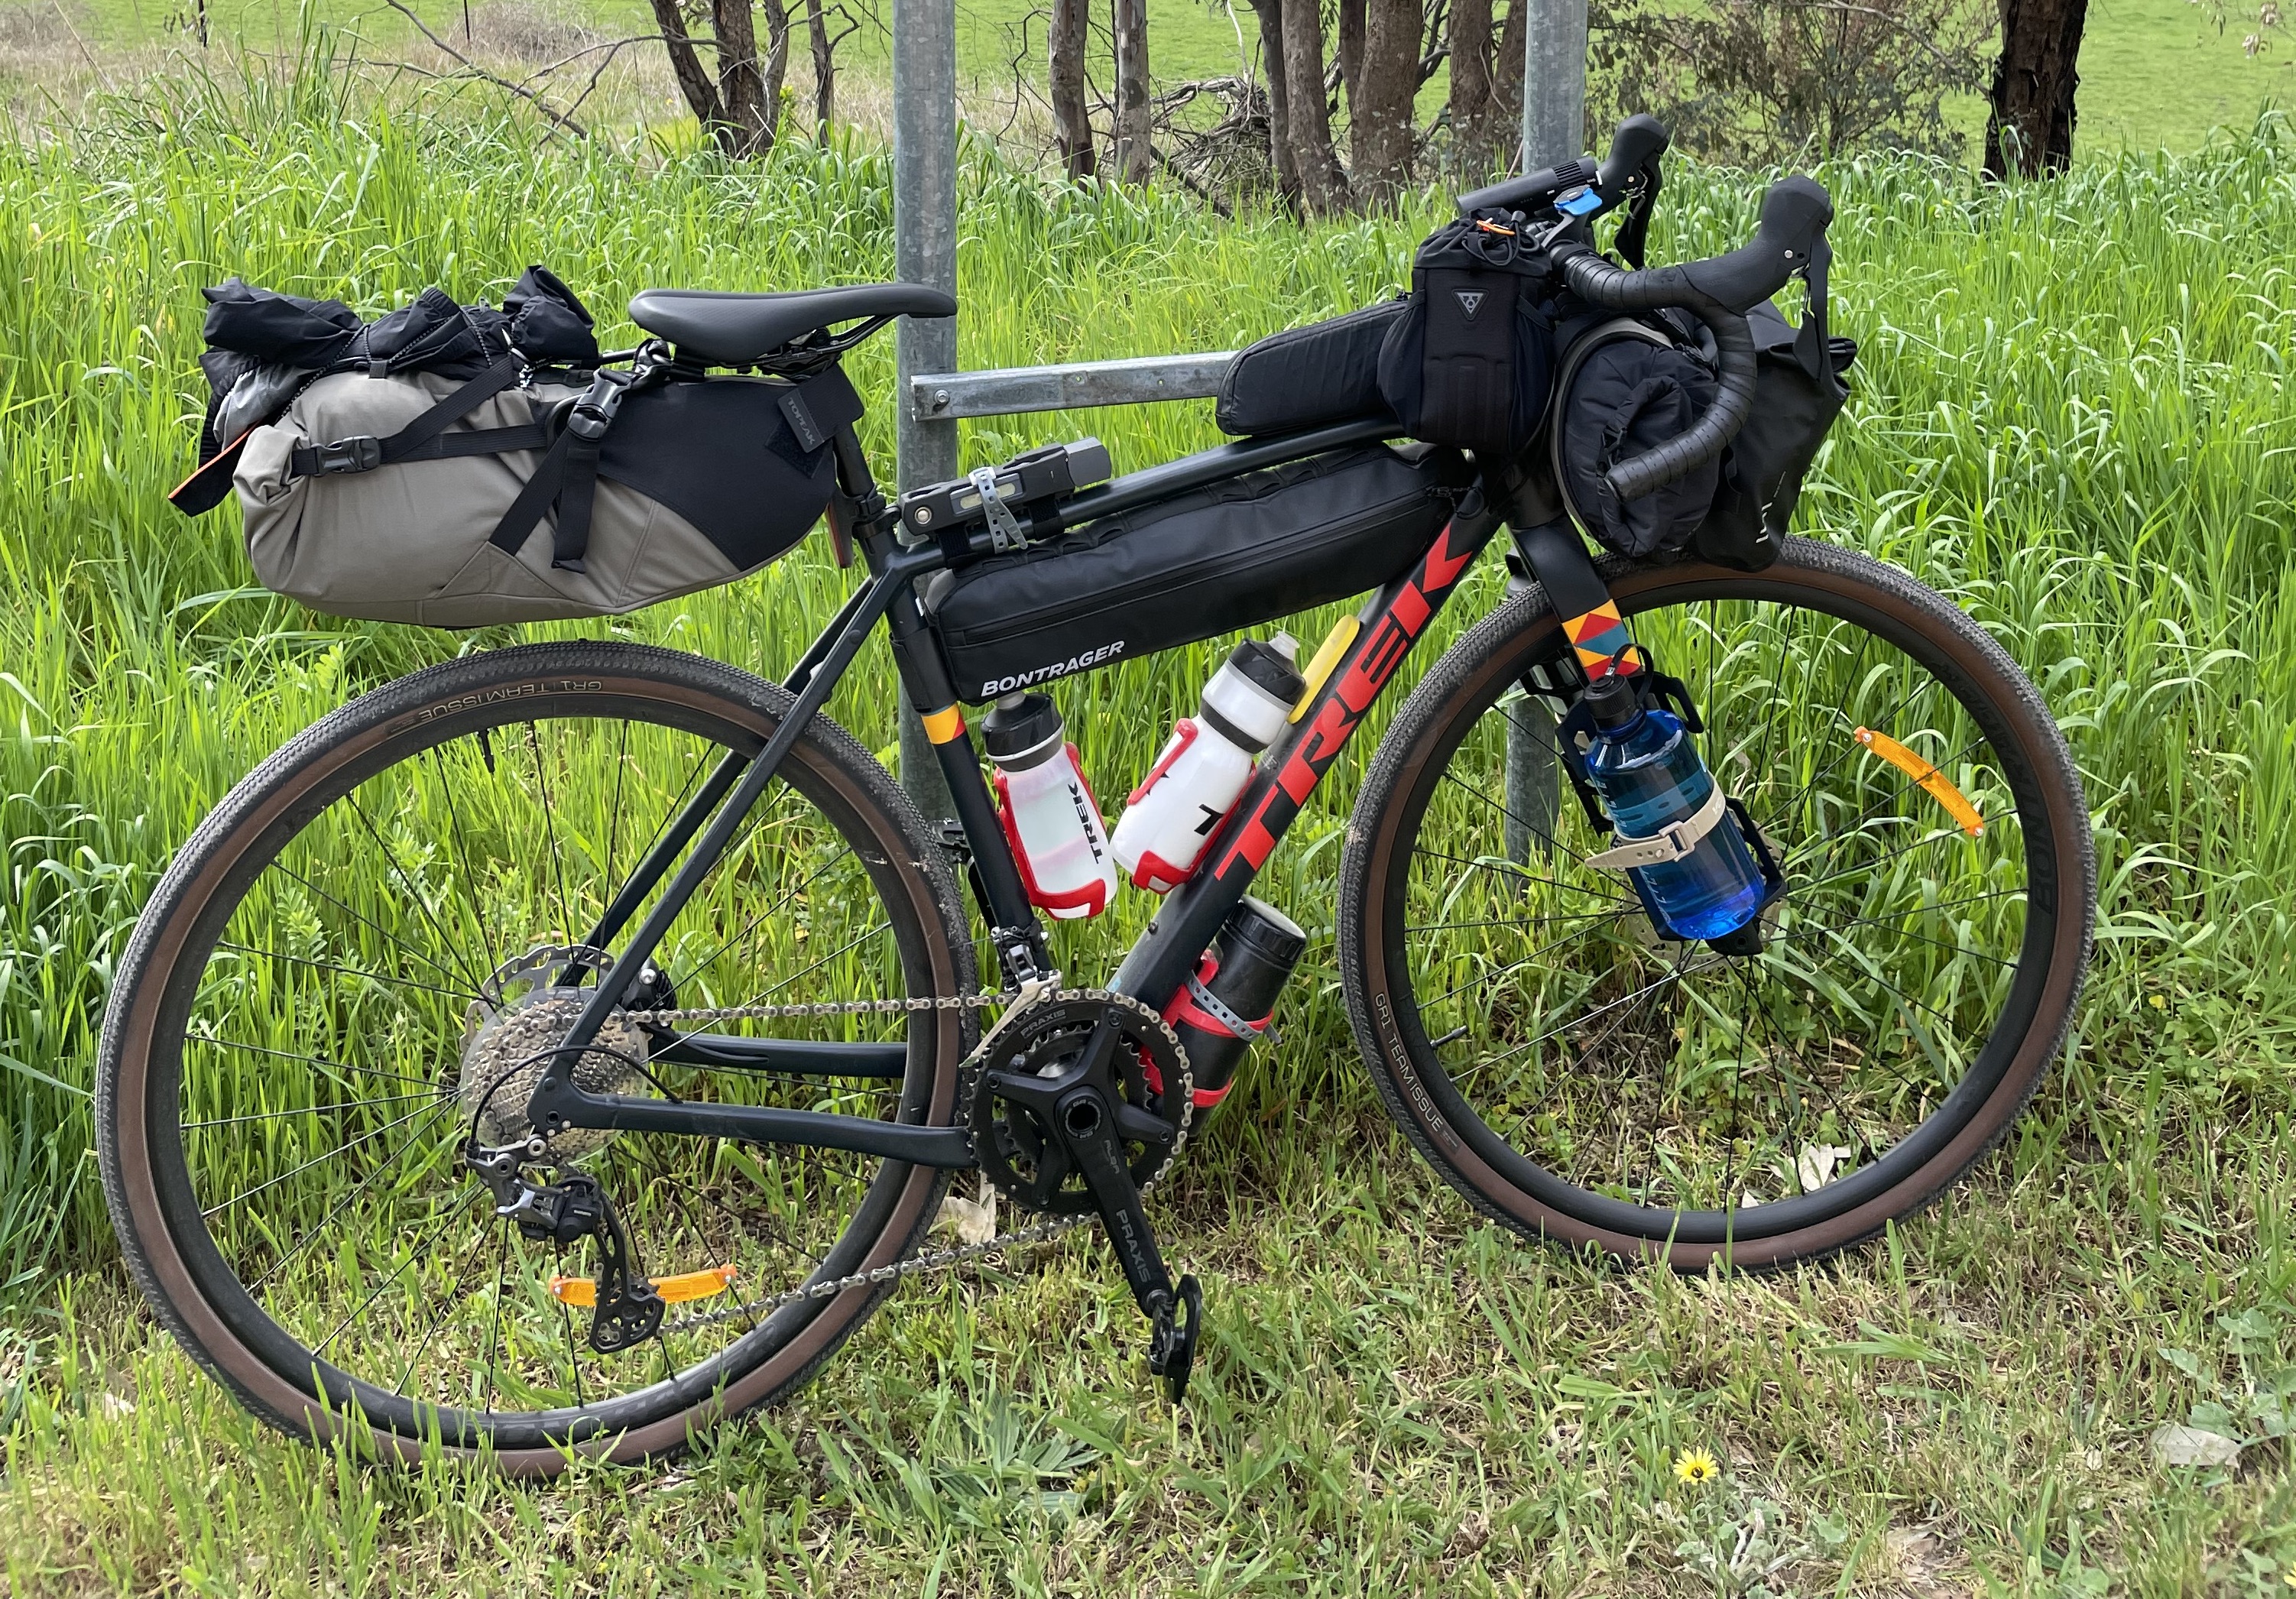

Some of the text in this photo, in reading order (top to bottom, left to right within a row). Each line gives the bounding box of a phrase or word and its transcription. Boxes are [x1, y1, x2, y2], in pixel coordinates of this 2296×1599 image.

[787, 397, 816, 445] TOPEAK
[486, 683, 550, 702] TEAM
[559, 680, 602, 691] GR1
[981, 640, 1125, 698] BONTRAGER
[418, 695, 482, 721] ISSUE
[1214, 522, 1473, 881] TREK
[1067, 780, 1103, 864] TREK
[1020, 1008, 1067, 1037] PRAXIS
[1375, 993, 1444, 1132] GR1 TEAM ISSUE
[1116, 1208, 1151, 1283] PRAXIS
